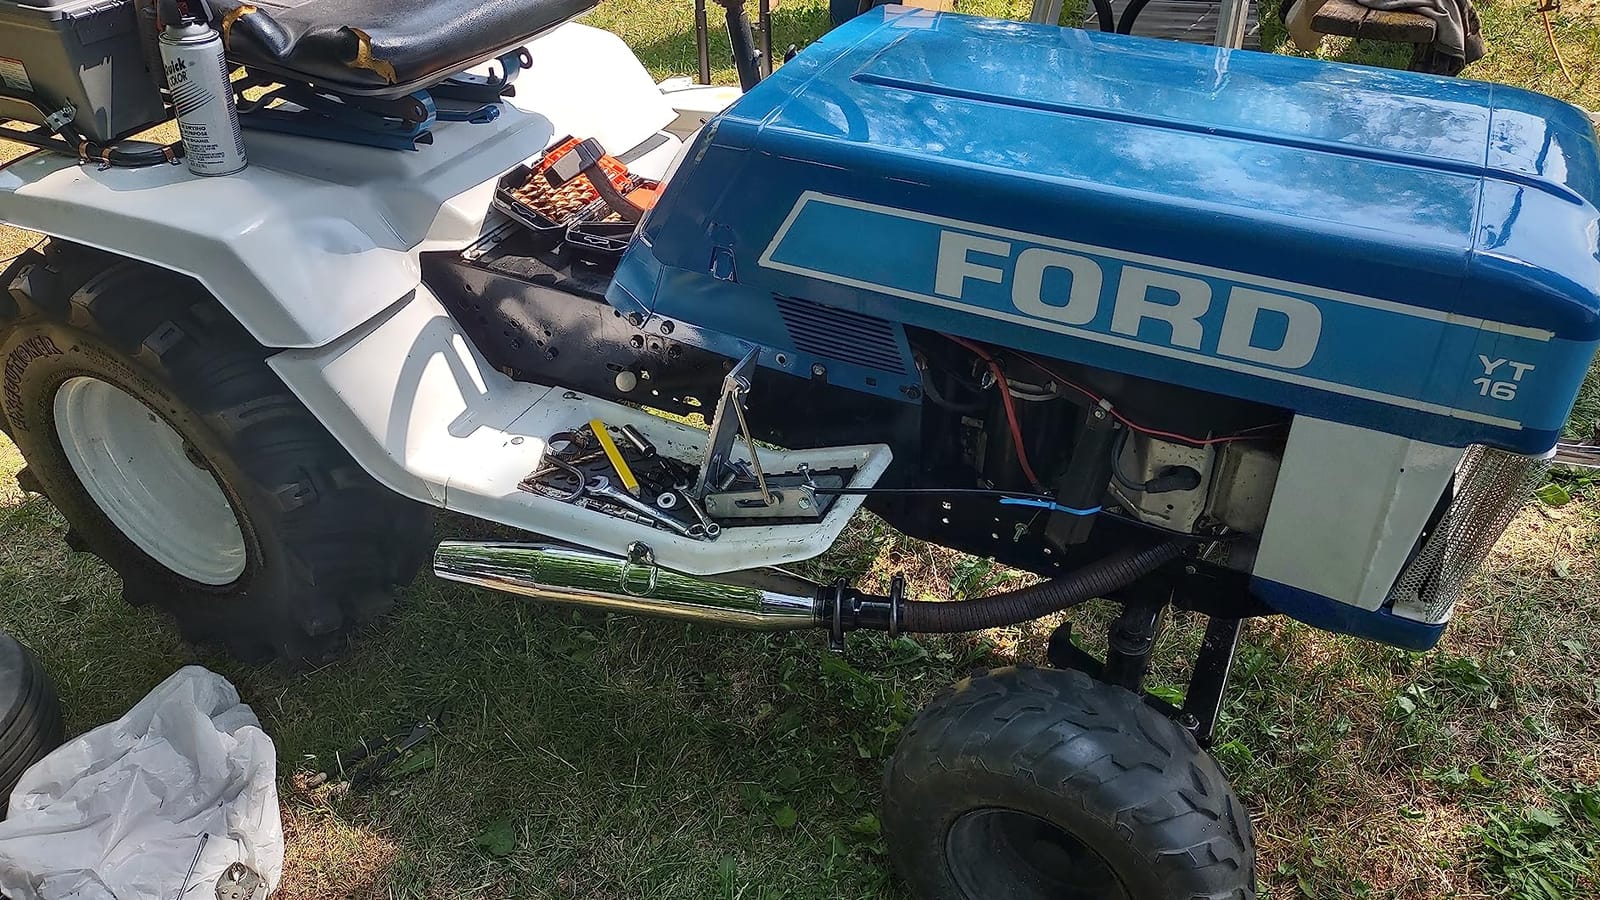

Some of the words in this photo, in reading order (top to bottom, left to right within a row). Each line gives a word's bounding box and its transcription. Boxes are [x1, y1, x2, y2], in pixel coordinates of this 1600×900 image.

[934, 229, 1323, 370] FORD
[1478, 354, 1536, 381] YT
[1473, 377, 1517, 401] 16
